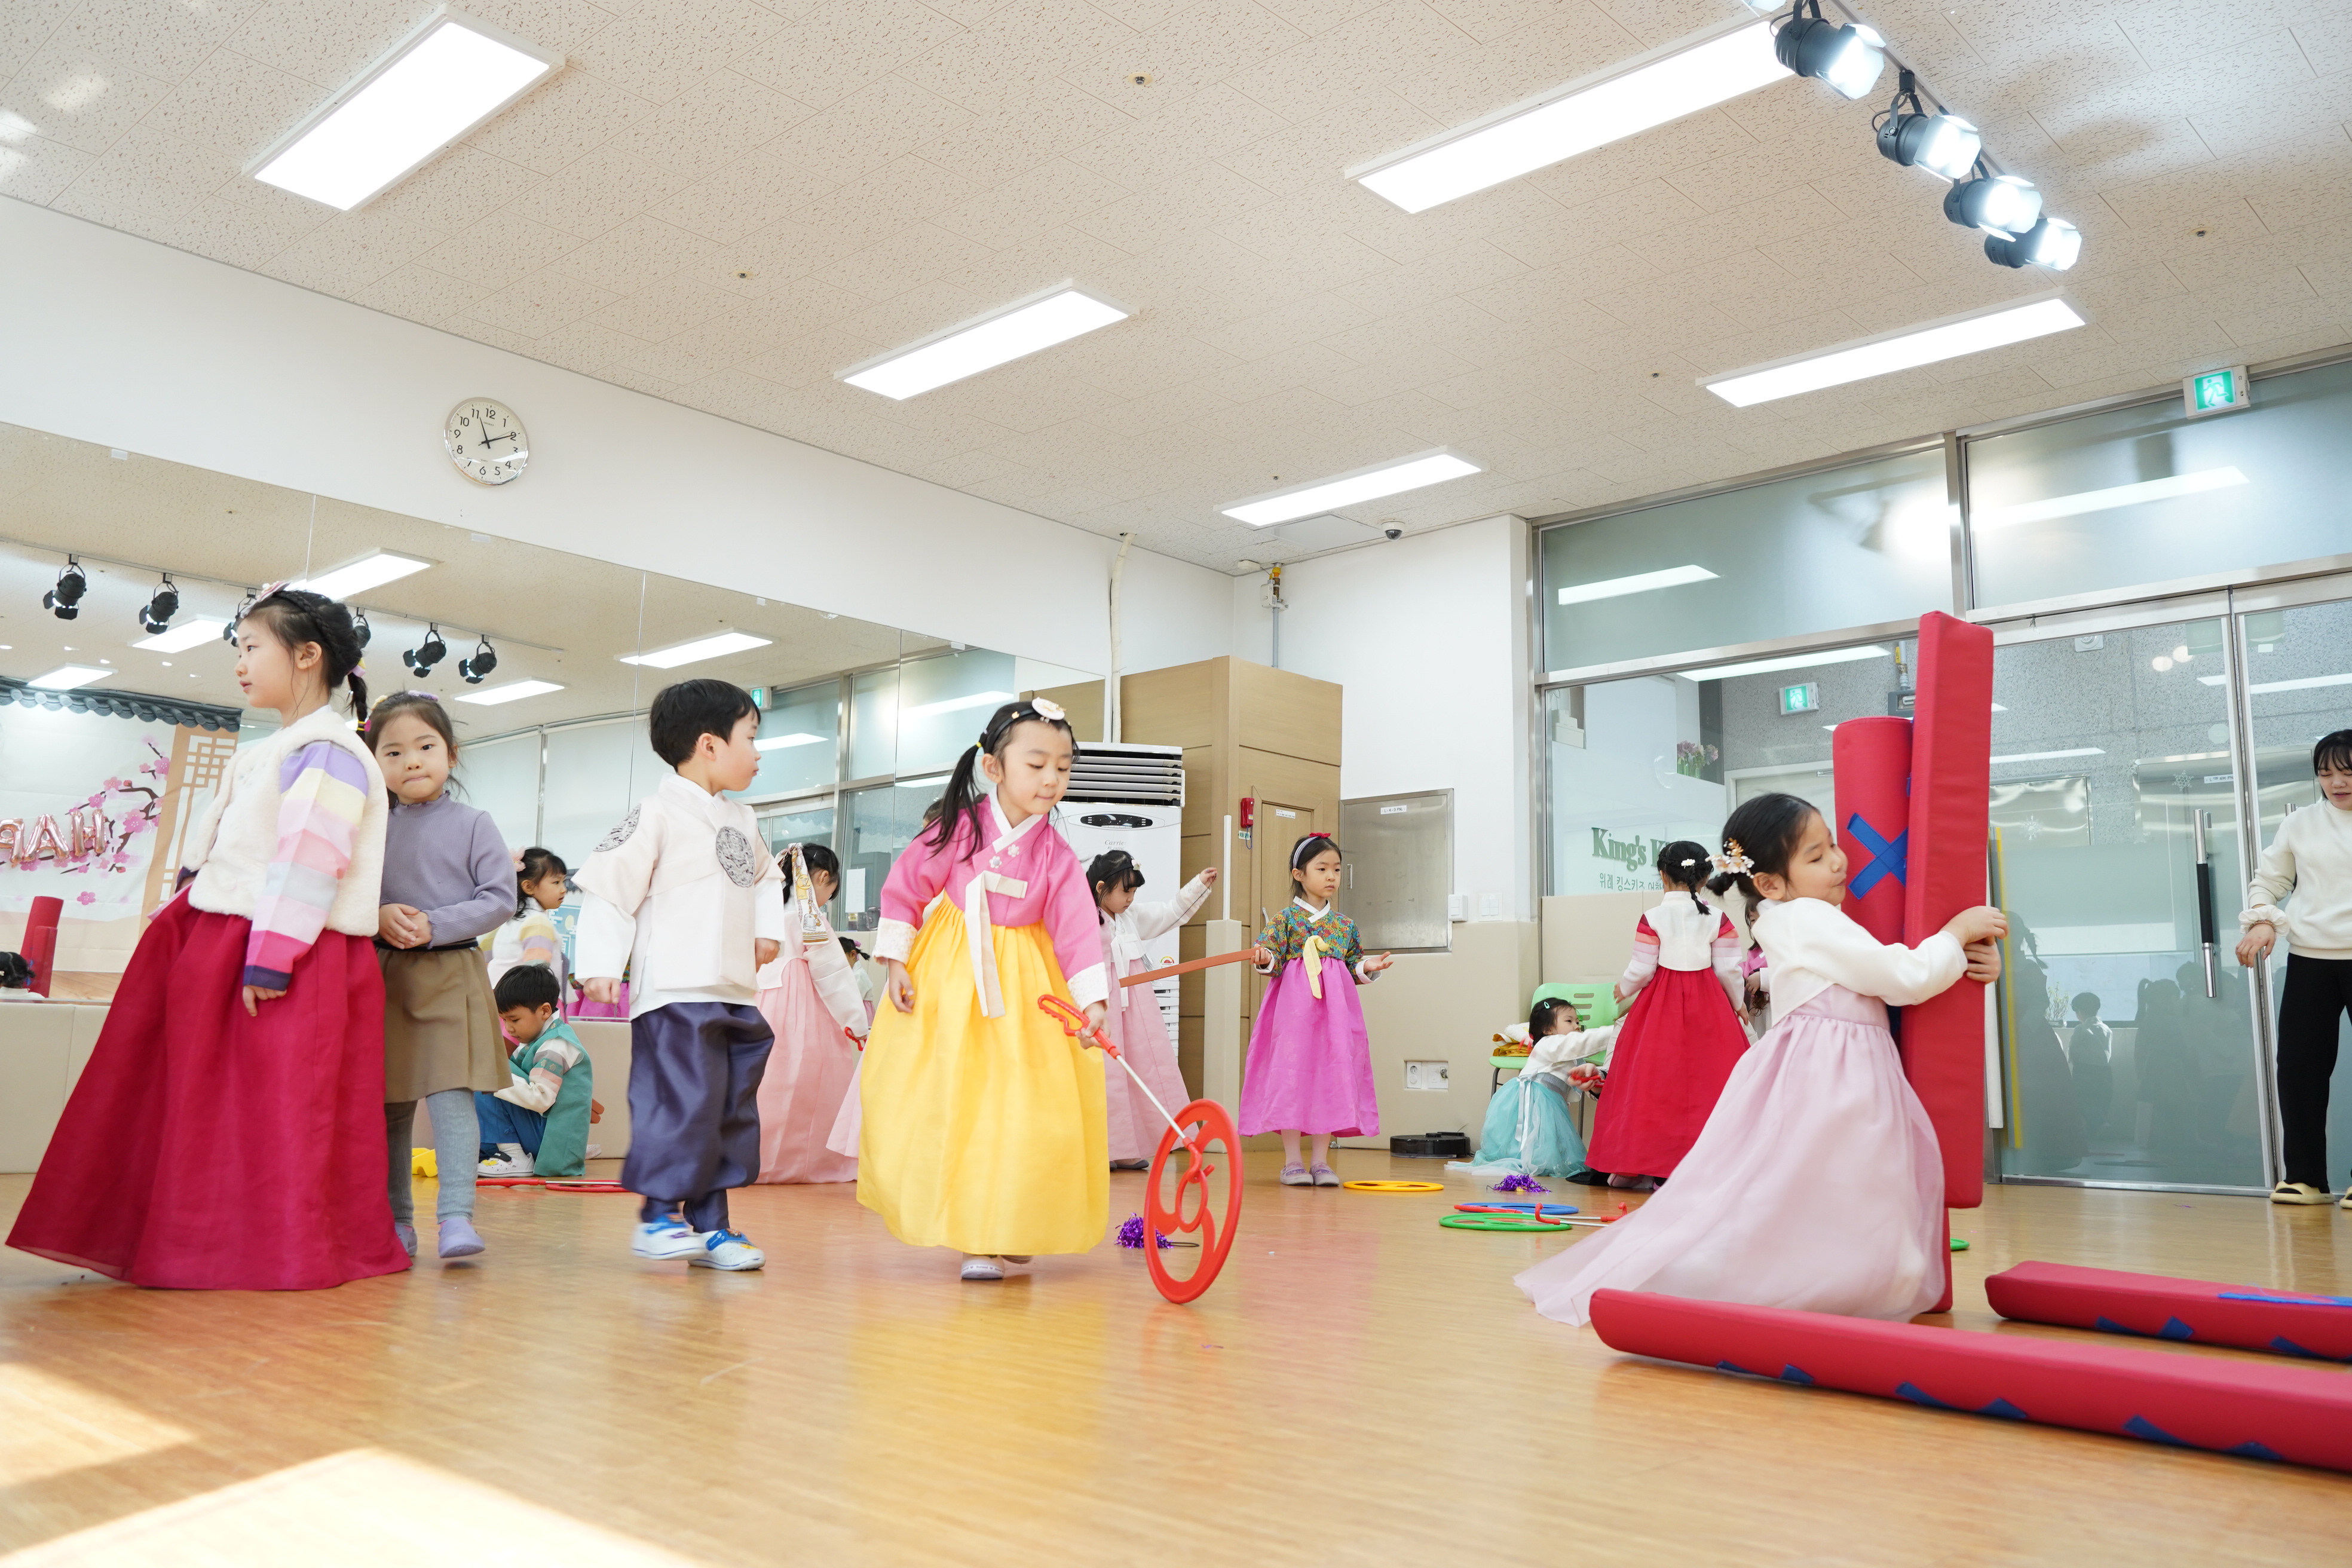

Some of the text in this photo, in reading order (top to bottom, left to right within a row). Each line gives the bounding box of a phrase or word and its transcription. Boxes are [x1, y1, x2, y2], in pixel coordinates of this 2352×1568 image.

[471, 408, 479, 419] 11
[486, 408, 495, 419] 12
[460, 416, 469, 427] 10
[503, 418, 506, 427] 1
[454, 429, 461, 438] 9
[510, 431, 516, 441] 2
[457, 445, 463, 454] 8
[467, 457, 471, 467] 7
[479, 466, 486, 475] 6
[494, 466, 500, 476] 5
[1591, 827, 1647, 872] King's
[1600, 872, 1613, 889] 위례
